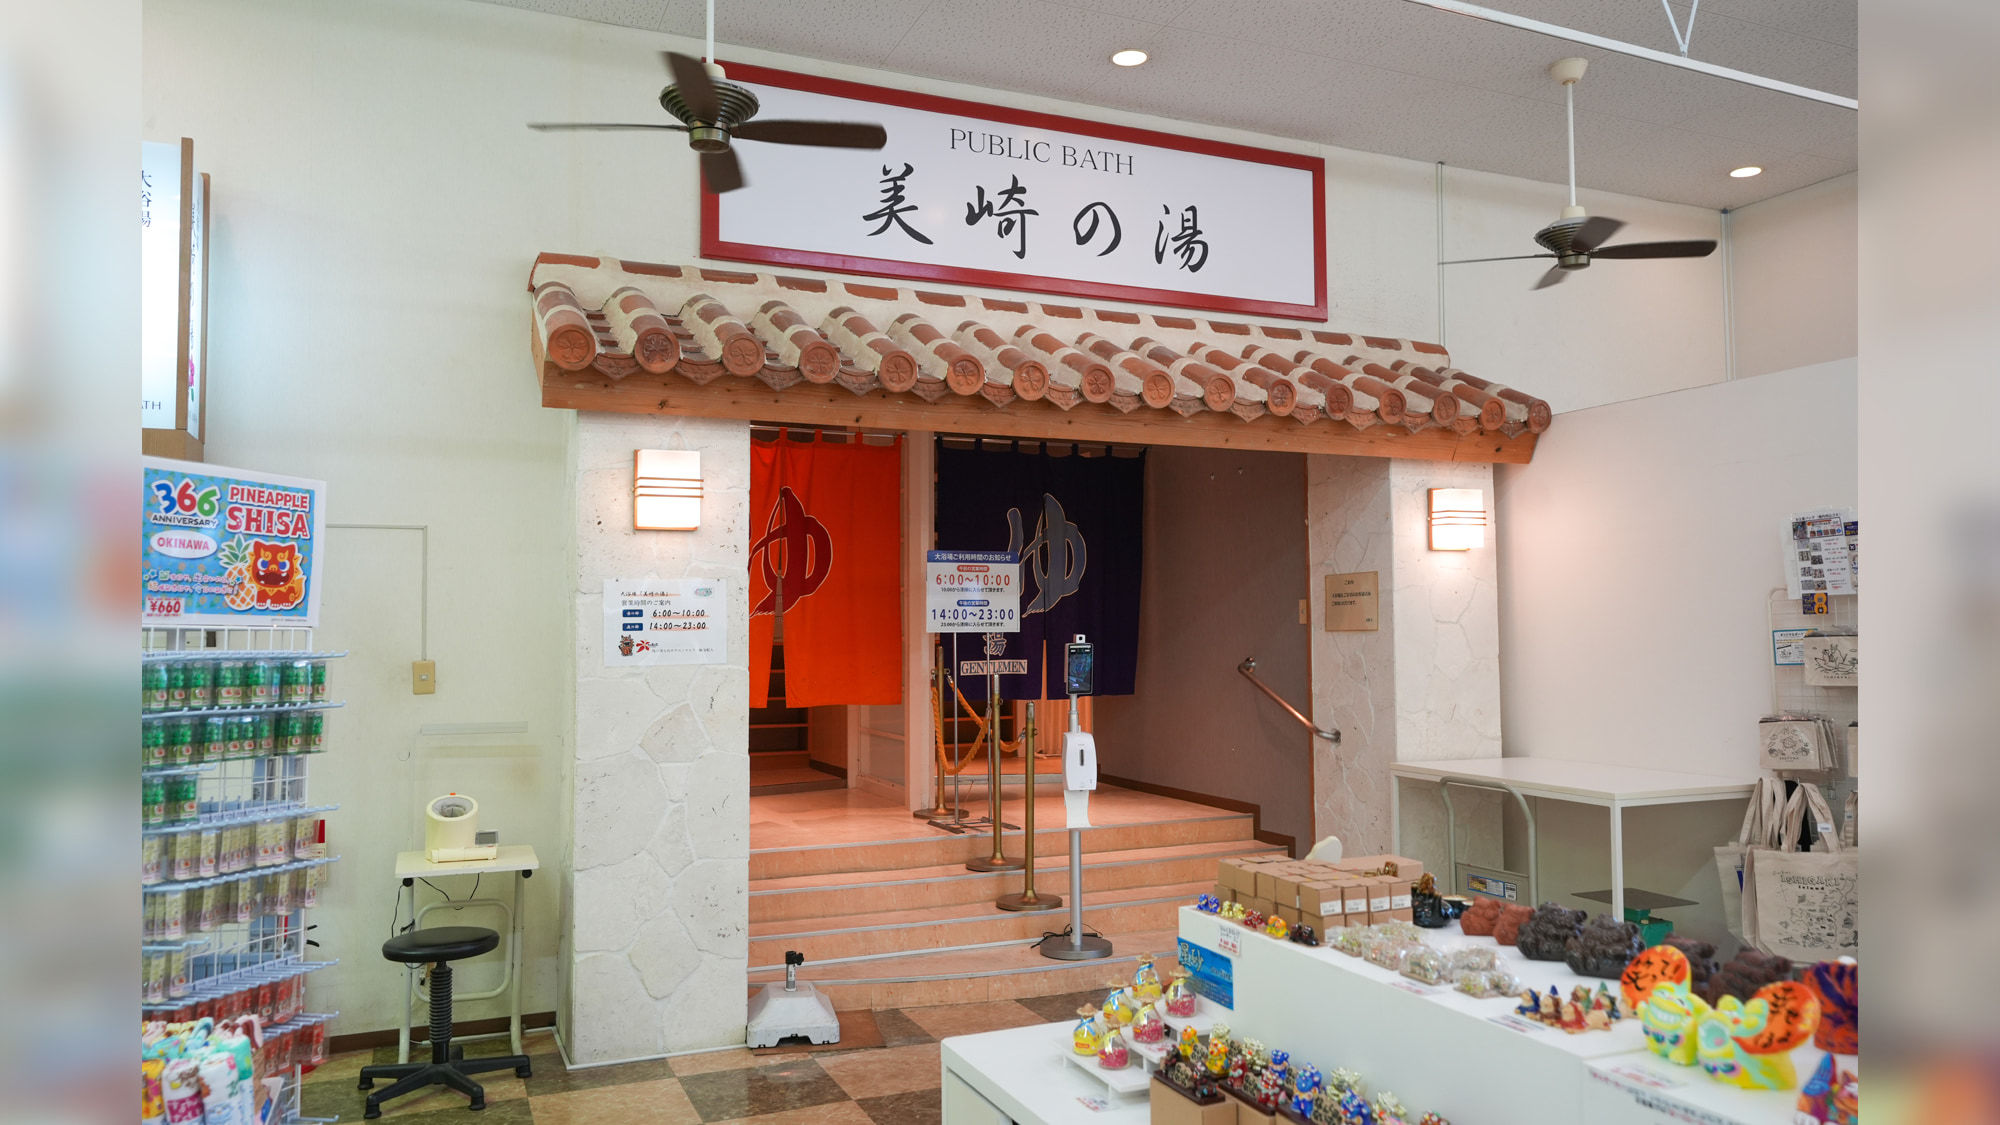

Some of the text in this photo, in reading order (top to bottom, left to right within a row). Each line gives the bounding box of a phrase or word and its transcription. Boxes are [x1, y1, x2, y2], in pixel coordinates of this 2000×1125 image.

[950, 127, 1135, 176] PUBLIC BATH
[862, 162, 1209, 273] 美崎の湯
[141, 400, 161, 410] TH
[155, 481, 219, 517] 366
[230, 486, 309, 510] PINEAPPLE
[152, 514, 218, 528] ANNIVERSARY
[227, 505, 310, 538] SHISA
[157, 537, 210, 551] OKINAWA
[150, 600, 181, 613] ¥660
[961, 661, 1026, 674] GENTLEMEN
